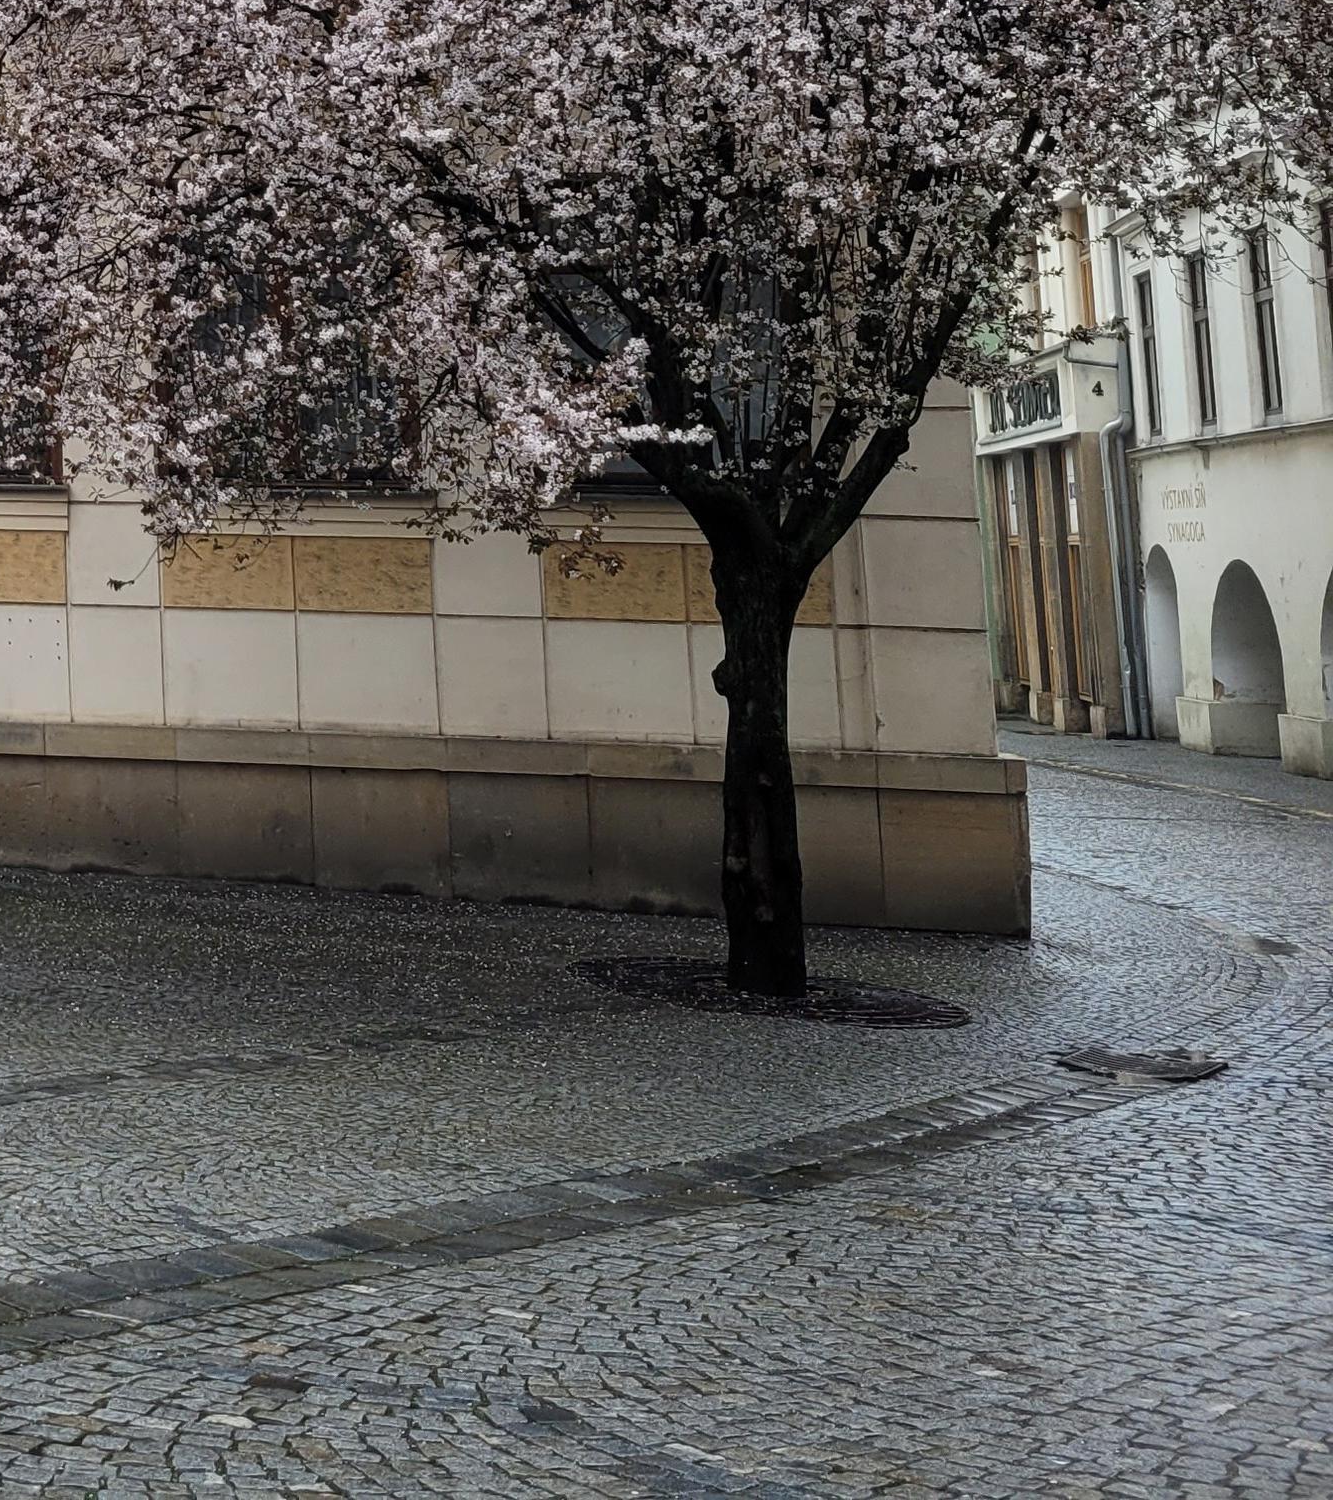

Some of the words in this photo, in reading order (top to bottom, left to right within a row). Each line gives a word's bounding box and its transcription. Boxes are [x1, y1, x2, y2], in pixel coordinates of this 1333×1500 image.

[1092, 380, 1104, 396] 4
[1160, 483, 1194, 510] VÝSTAVNÍ
[1167, 521, 1206, 542] SYNAGOGA
